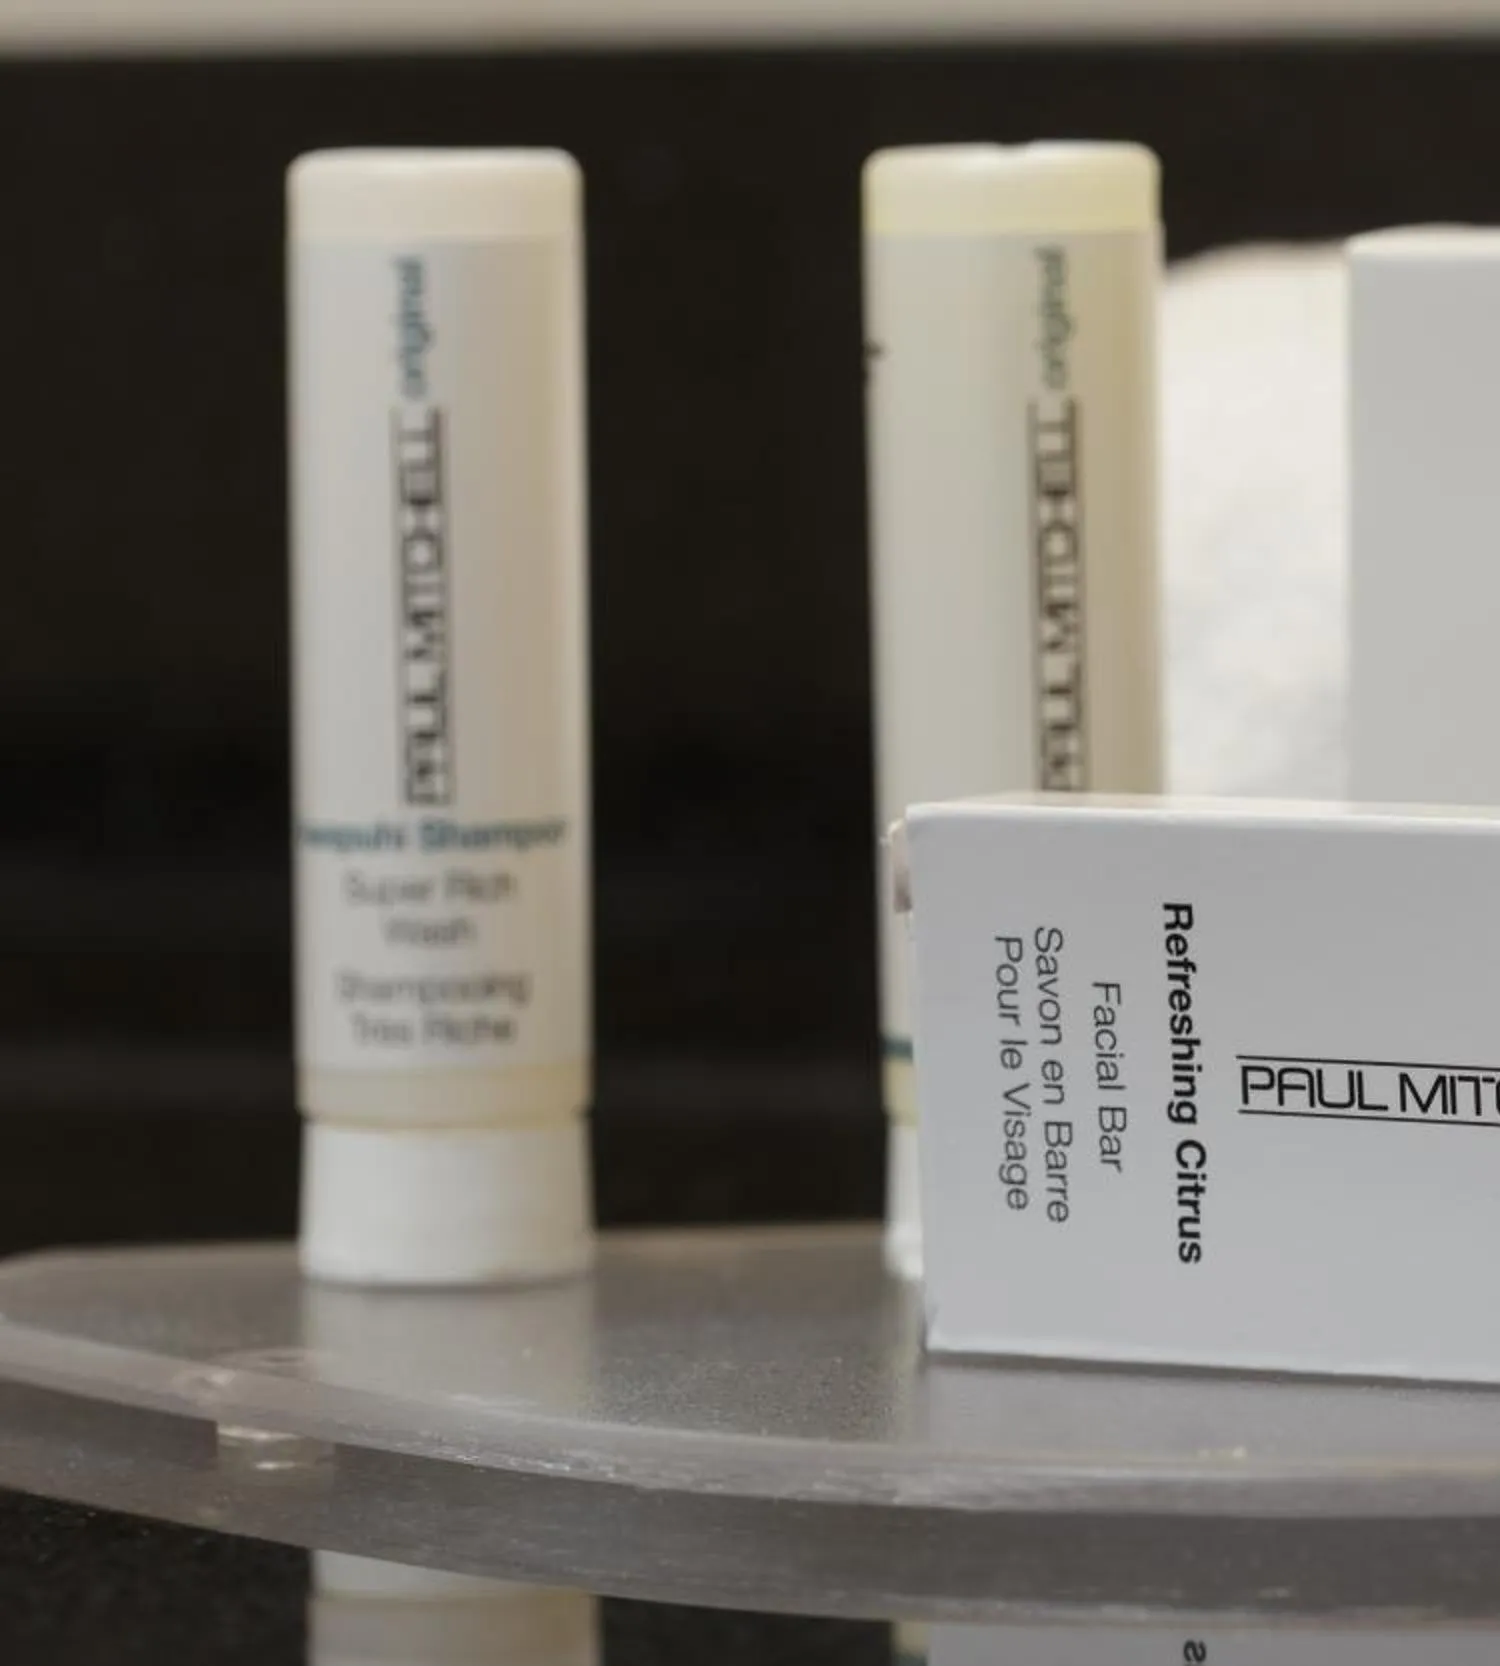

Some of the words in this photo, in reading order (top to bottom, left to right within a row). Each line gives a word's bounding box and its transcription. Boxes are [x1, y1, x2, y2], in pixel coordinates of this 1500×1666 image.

[995, 936, 1024, 1026] Pour
[1034, 926, 1064, 1045] Savon
[1163, 903, 1202, 1125] Refreshing
[1001, 1039, 1028, 1070] le
[1040, 1059, 1065, 1105] en
[1092, 981, 1126, 1090] Facial
[1099, 1106, 1127, 1173] Bar
[1241, 1065, 1388, 1112] PAUL
[999, 1083, 1031, 1211] Visage
[1044, 1121, 1074, 1223] Barre
[1175, 1139, 1206, 1264] Citrus
